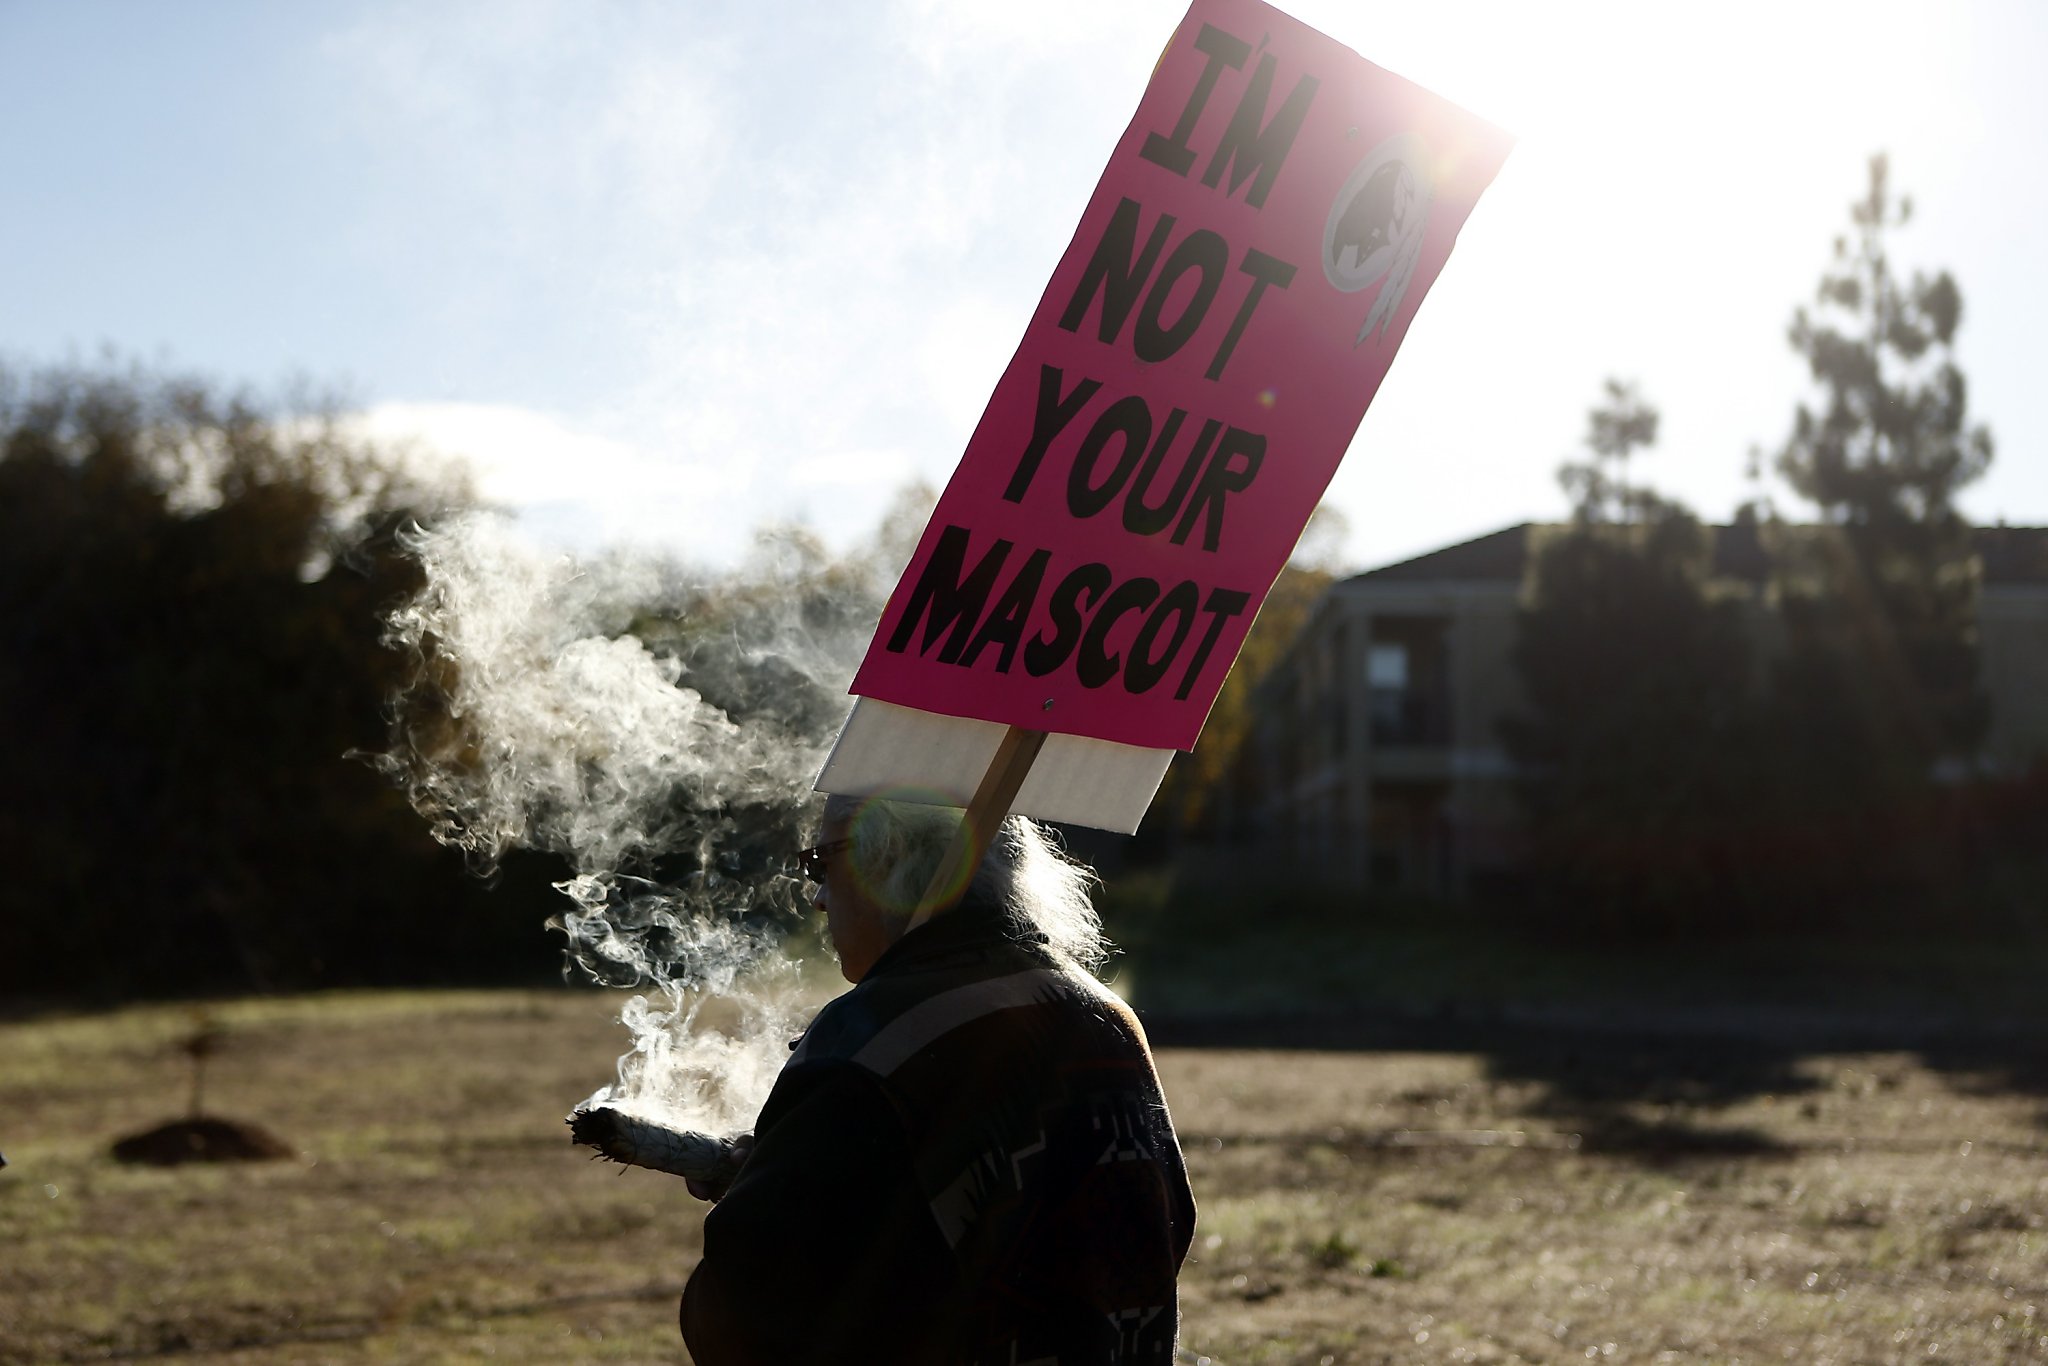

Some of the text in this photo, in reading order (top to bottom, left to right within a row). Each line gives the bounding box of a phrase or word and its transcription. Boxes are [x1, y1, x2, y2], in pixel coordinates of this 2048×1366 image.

[1139, 22, 1321, 210] I'M
[1059, 196, 1299, 382] NOT
[1002, 363, 1268, 553] YOUR
[885, 524, 1252, 701] MASCOT
